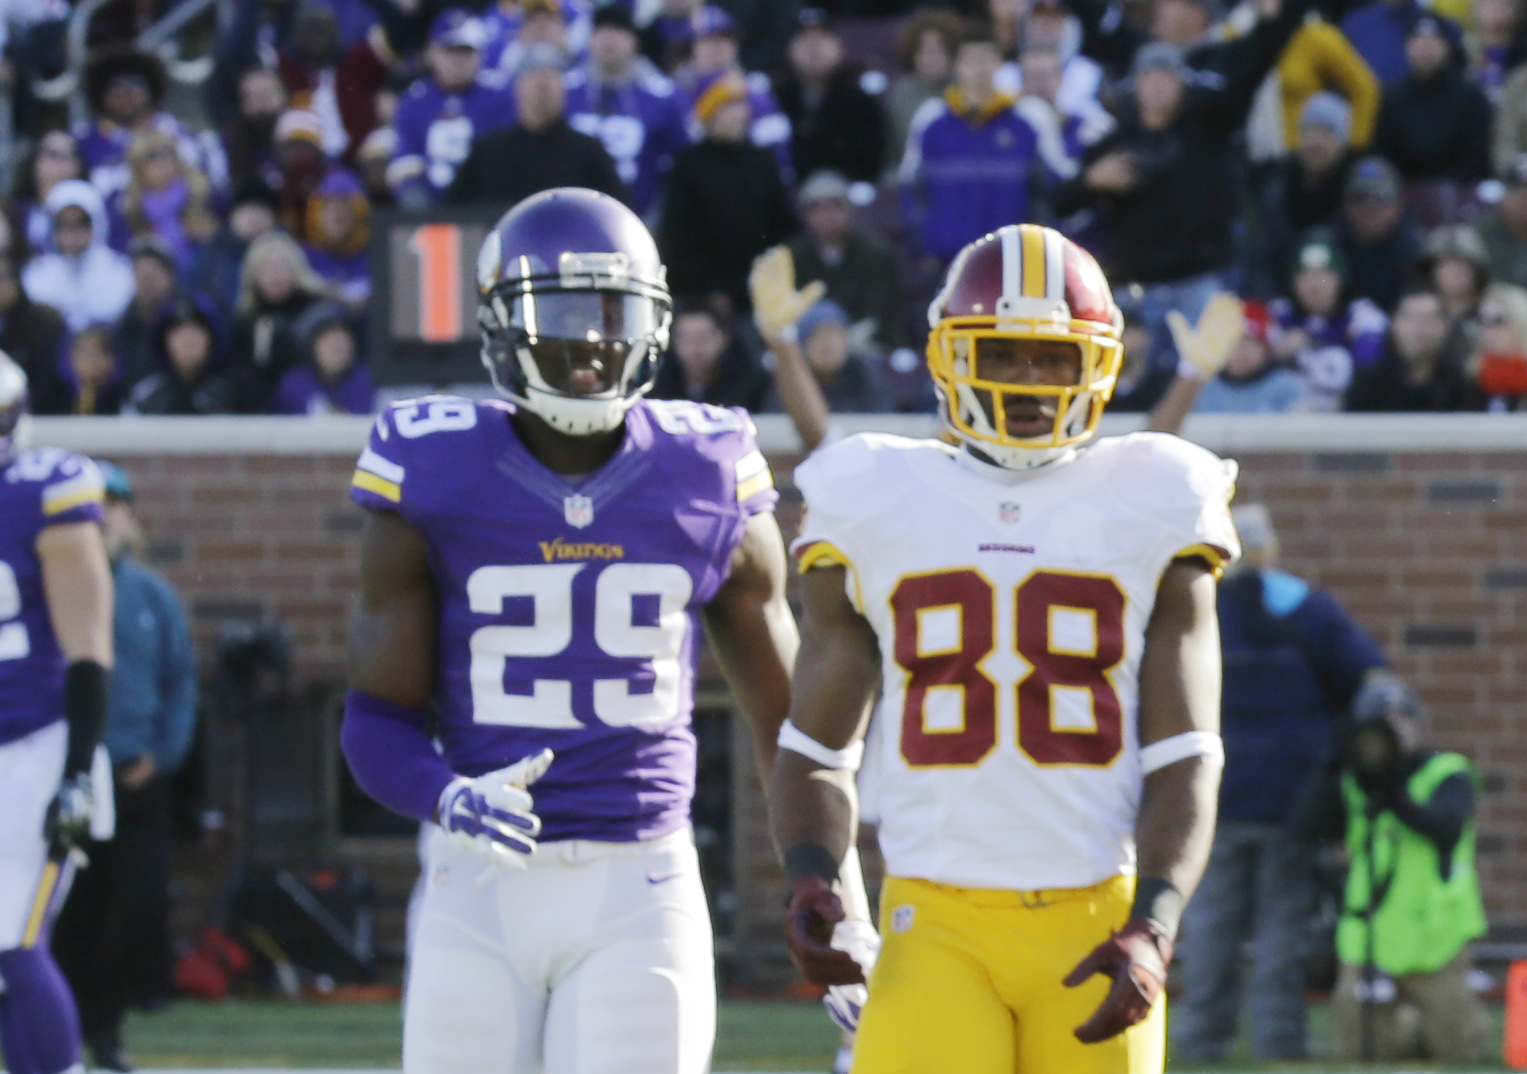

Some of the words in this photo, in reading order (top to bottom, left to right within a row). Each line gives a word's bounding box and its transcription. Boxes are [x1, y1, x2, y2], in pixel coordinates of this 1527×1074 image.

[410, 223, 461, 342] 1
[466, 562, 694, 730] 29
[889, 567, 1127, 770] 88
